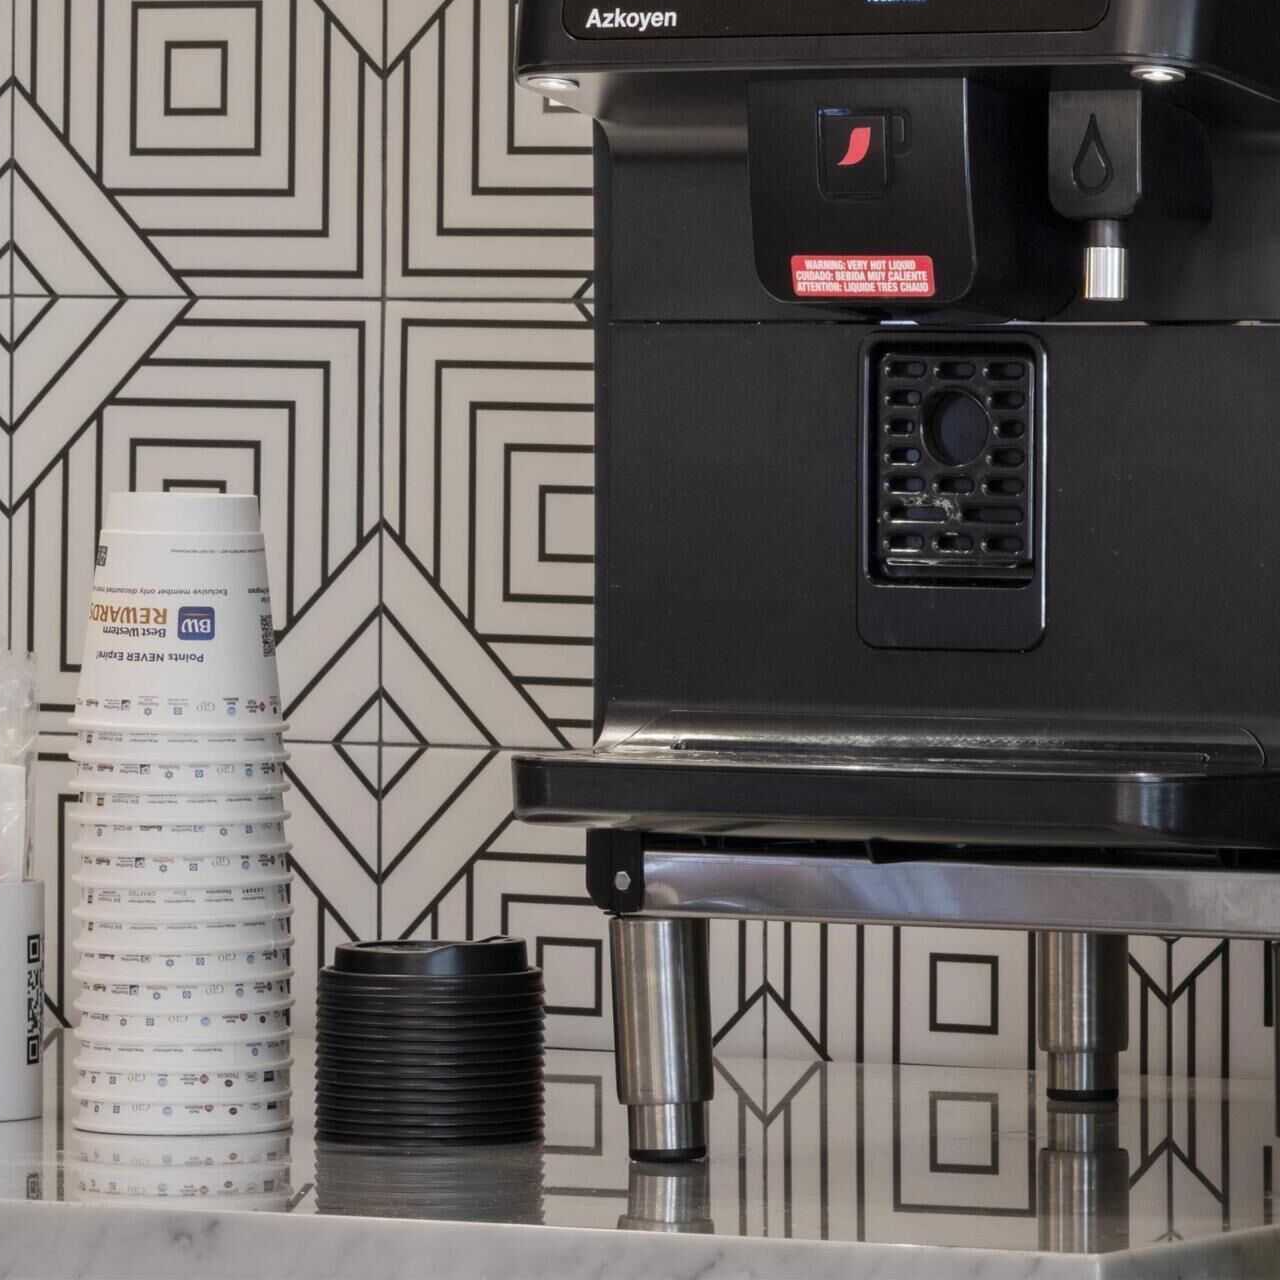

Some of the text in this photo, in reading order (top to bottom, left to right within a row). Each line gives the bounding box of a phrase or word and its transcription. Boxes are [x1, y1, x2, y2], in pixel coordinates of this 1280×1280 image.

[586, 8, 677, 32] Azkoyen
[805, 260, 916, 270] WARNING: VERY HOT LIQUID
[796, 271, 928, 281] CUIDADO: BEBIDA MUY CALIENTE
[797, 282, 842, 292] ATTENTION:
[844, 282, 876, 293] LIQUIDE
[900, 282, 929, 292] CHAUD
[106, 585, 138, 595] discounted
[140, 586, 156, 596] only
[158, 587, 191, 595] member
[192, 587, 228, 596] Exclusive
[180, 618, 212, 633] BW
[103, 625, 167, 638] Best Western
[96, 650, 205, 663] Points NEVER Expire!
